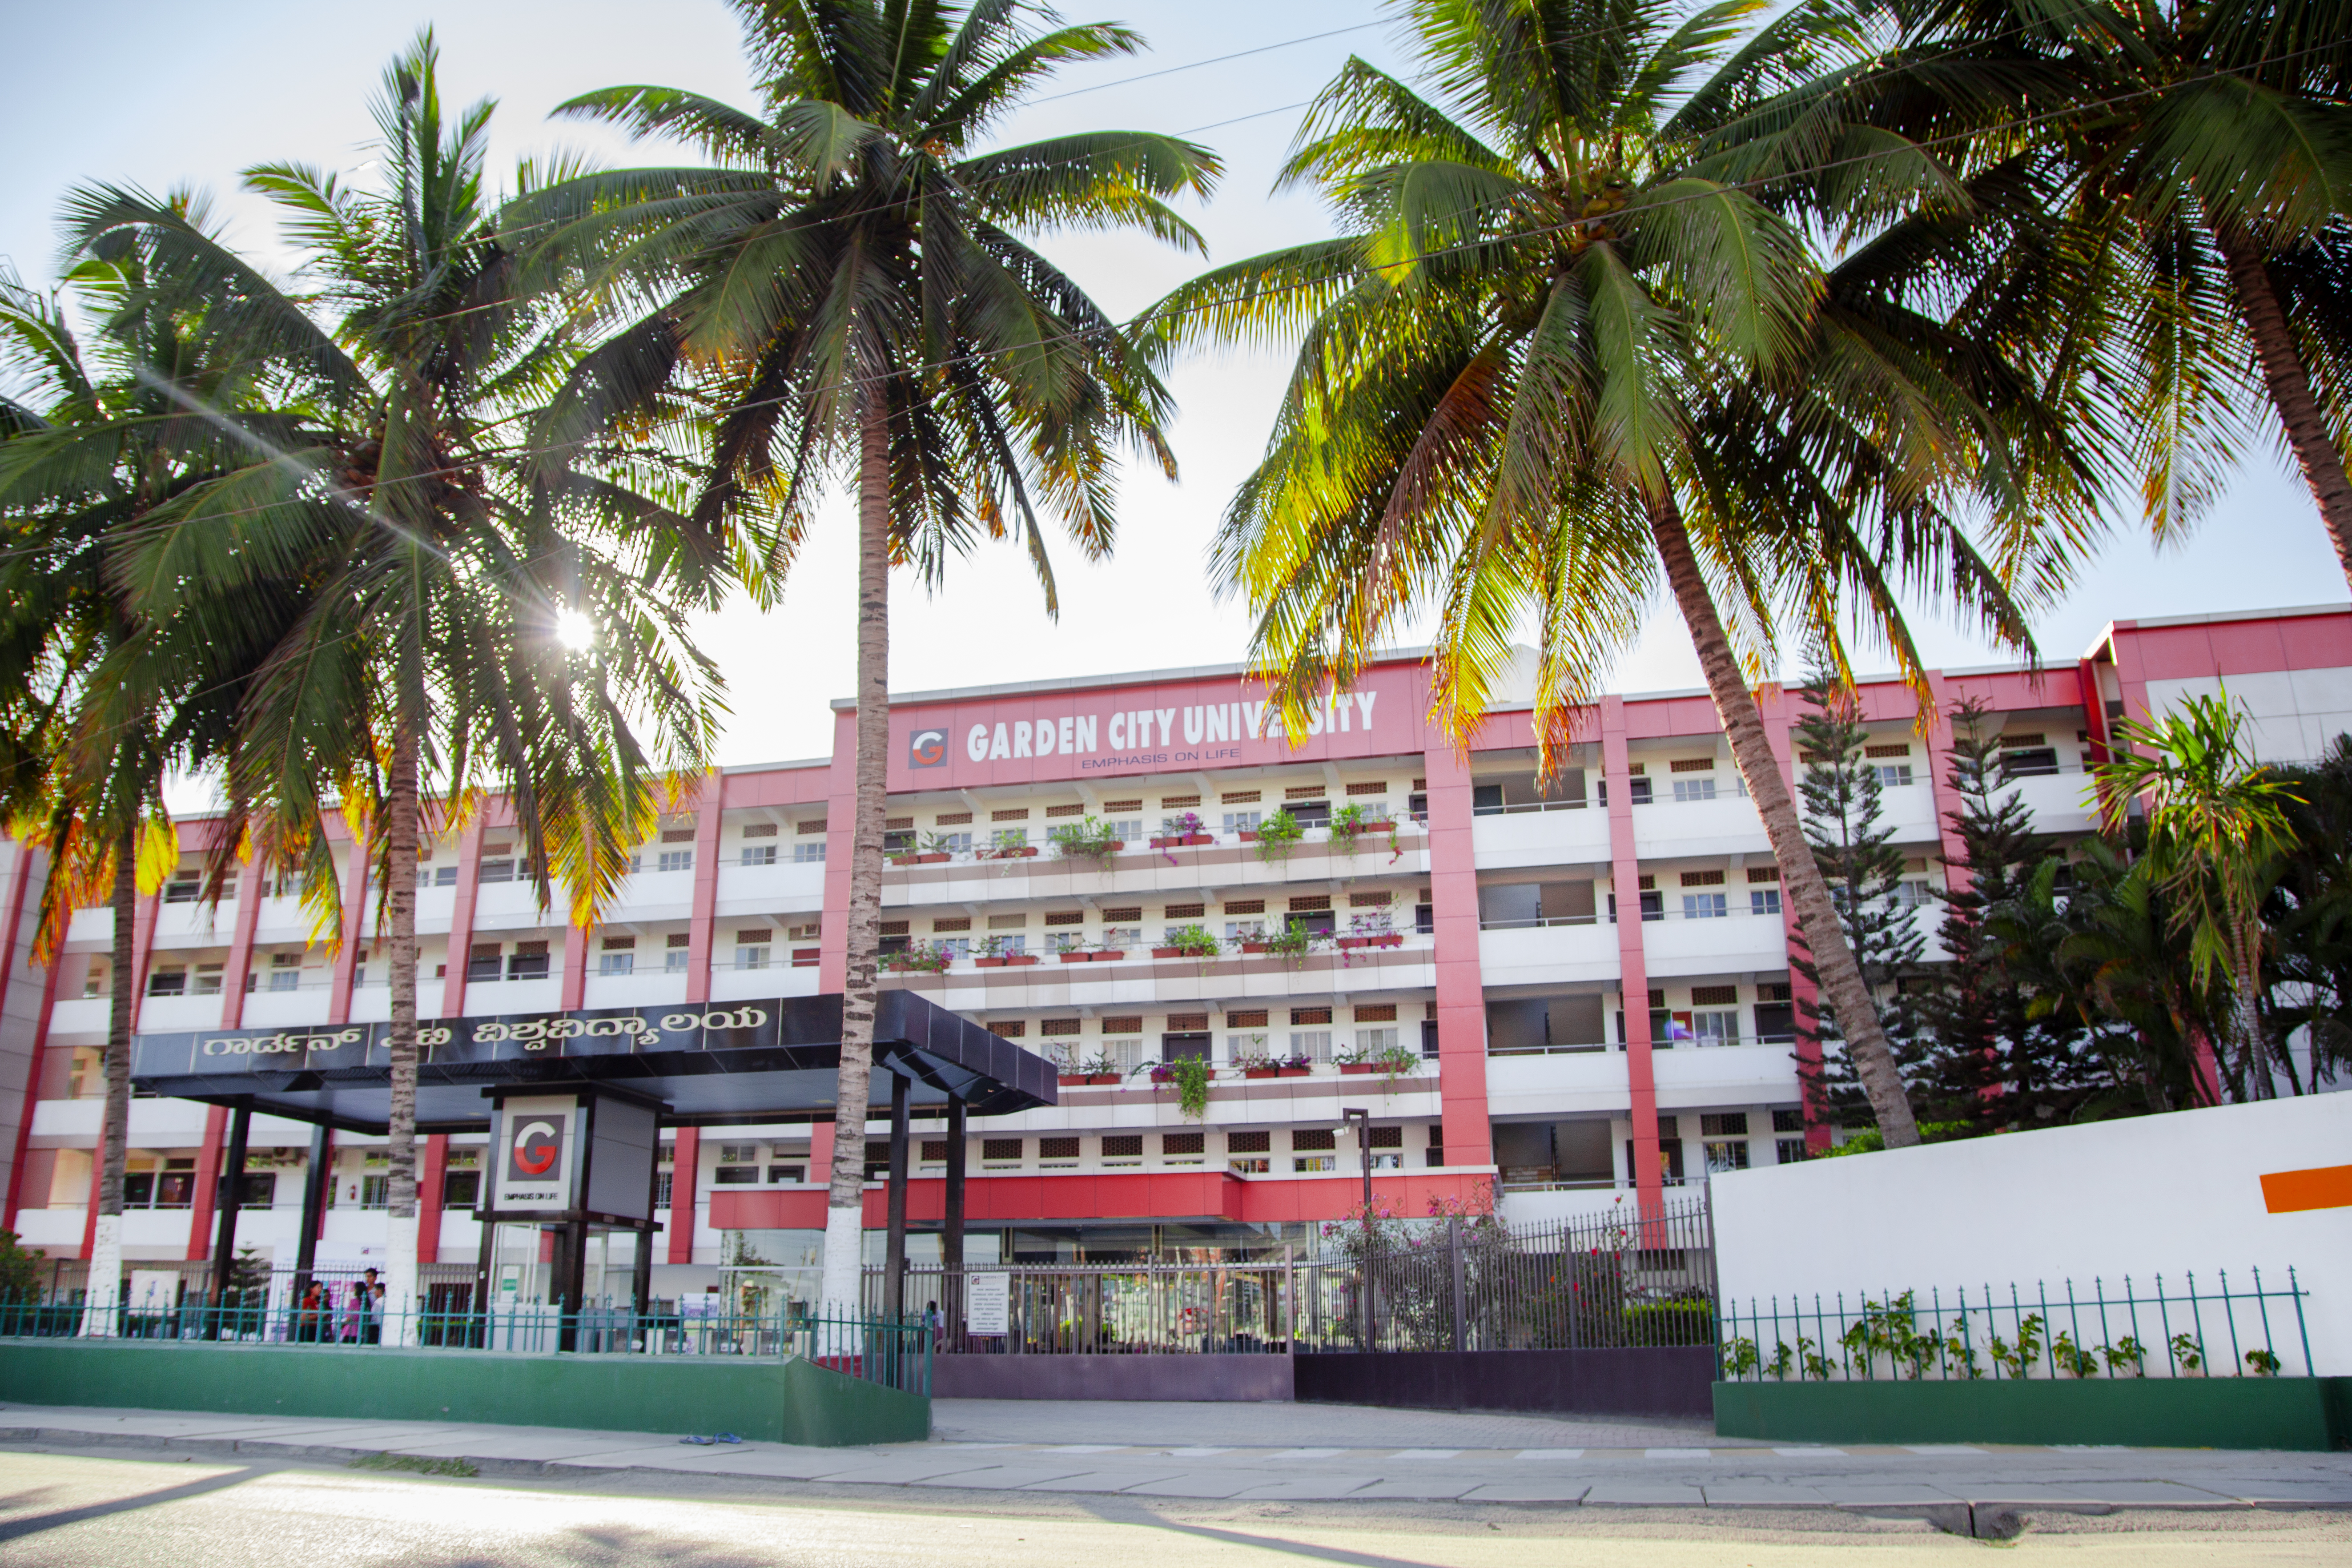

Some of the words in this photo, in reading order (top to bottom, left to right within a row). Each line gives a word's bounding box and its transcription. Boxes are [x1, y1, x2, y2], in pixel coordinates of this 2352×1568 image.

[967, 715, 1097, 762] GARDEN
[1108, 708, 1176, 751] CITY
[1183, 691, 1377, 745] UNIVESITY
[913, 732, 944, 765] G
[1082, 753, 1167, 769] EMPHASIS
[1175, 752, 1198, 761] ON
[1206, 748, 1240, 760] LIFE
[203, 1028, 363, 1056] ಗಾರ್ಡನ್
[472, 1006, 767, 1051] ವಿಶ್ವವಿದ್ಯಾಲಯ
[514, 1121, 557, 1174] G
[504, 1193, 534, 1201] EMPHASIS
[545, 1192, 558, 1200] LIFE
